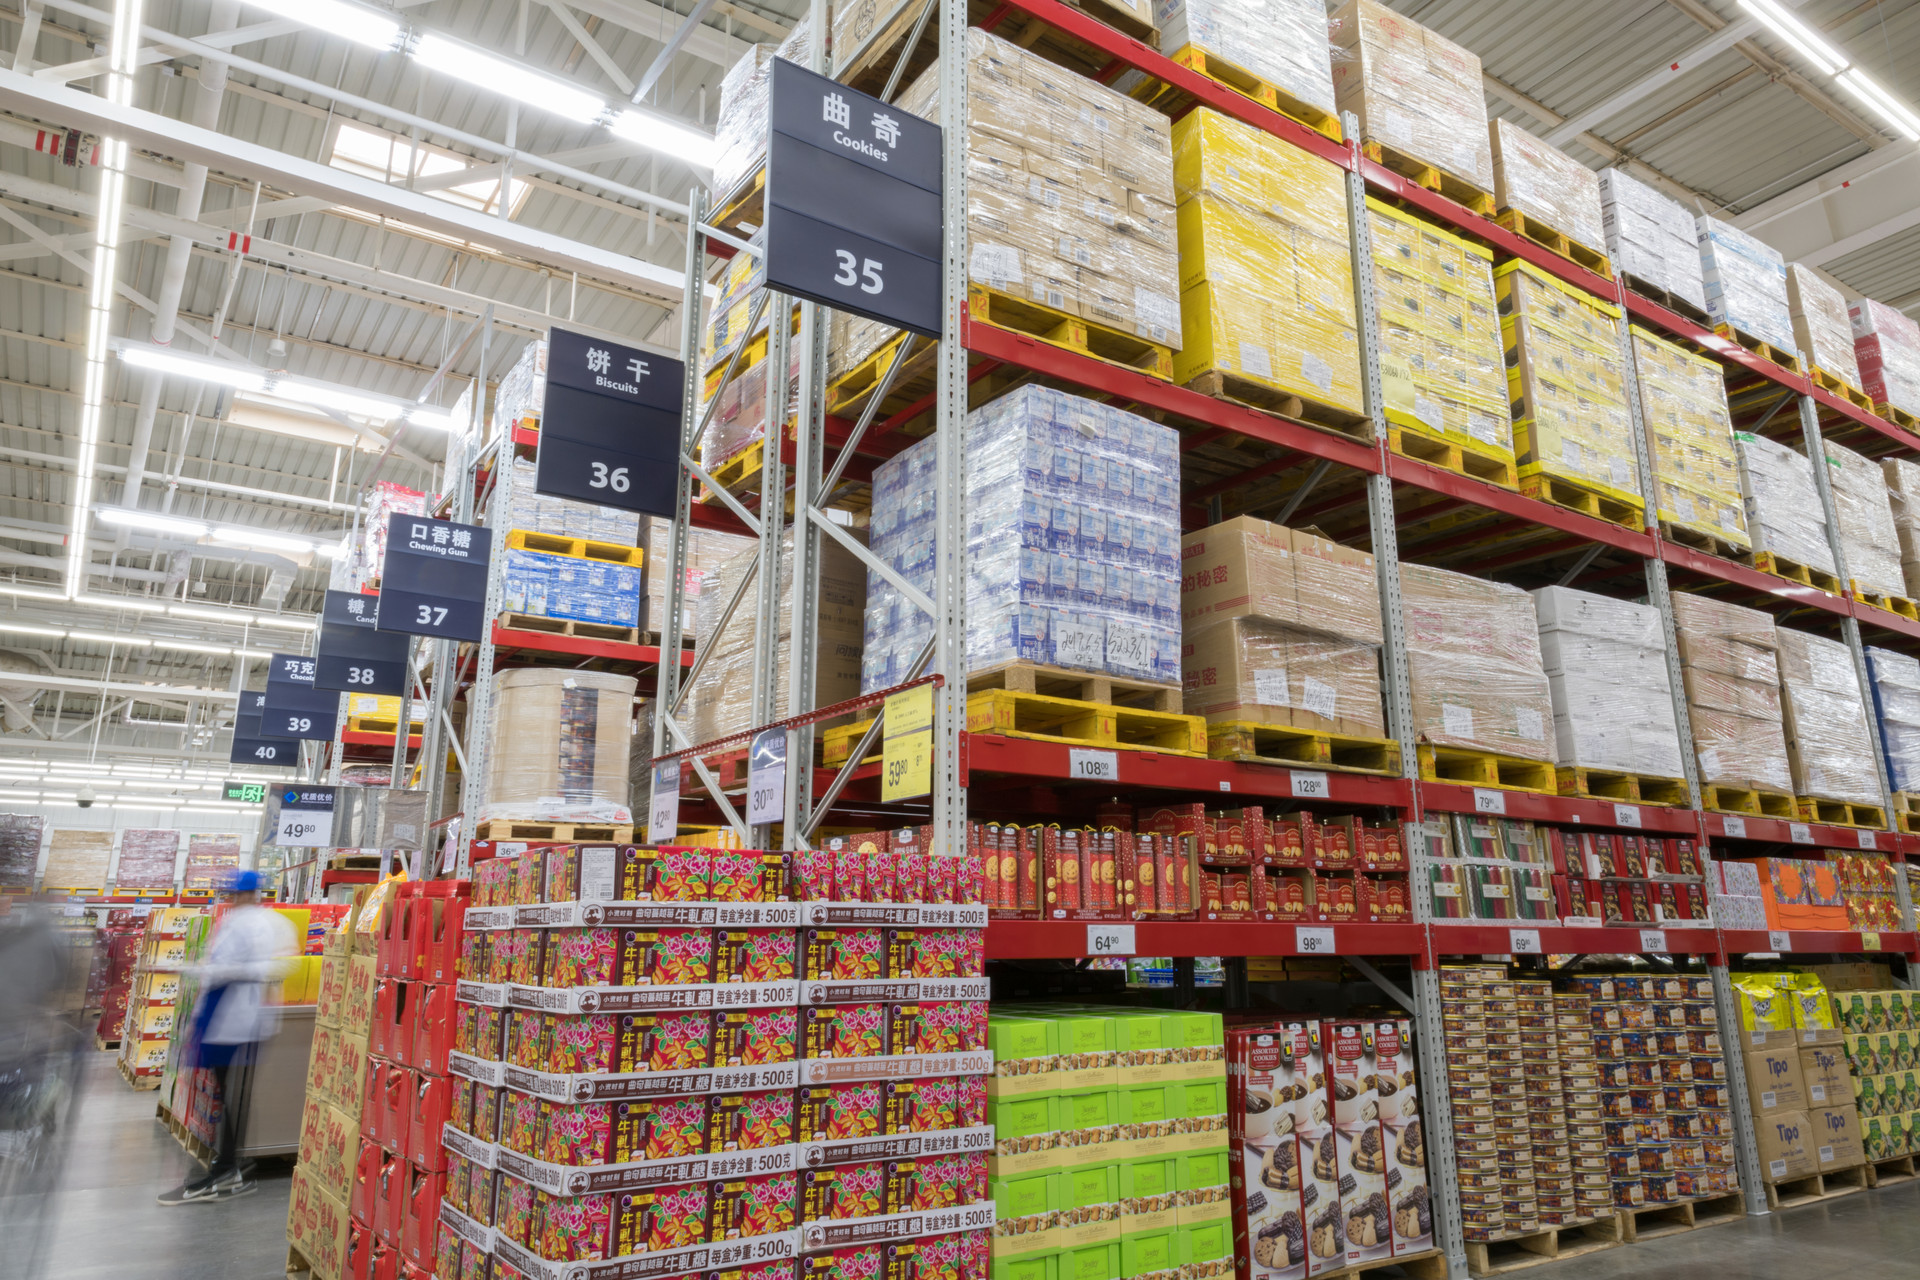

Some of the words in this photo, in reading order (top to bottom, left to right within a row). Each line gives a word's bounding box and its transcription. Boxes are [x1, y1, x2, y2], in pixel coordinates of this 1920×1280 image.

[823, 92, 901, 149] 曲奇
[833, 130, 888, 162] Cookies
[834, 249, 884, 295] 35
[974, 296, 987, 311] 12
[586, 347, 651, 383] 饼干
[595, 375, 639, 395] Biscuits
[589, 462, 631, 493] 36
[411, 523, 472, 549] 口香糖
[409, 541, 447, 555] Chewing
[448, 548, 468, 557] Gum
[347, 598, 379, 615] 糖
[416, 605, 449, 626] 37
[285, 660, 315, 675] 巧克
[347, 667, 375, 685] 38
[290, 674, 315, 682] Chocola
[1183, 667, 1217, 689] 秘密
[287, 717, 311, 732] 39
[255, 746, 276, 759] 40
[301, 792, 333, 802] 优质优价
[1766, 1057, 1788, 1078] Tipo
[1814, 1051, 1835, 1071] Tipo
[1825, 1112, 1845, 1132] Tipo
[1776, 1124, 1799, 1144] Tipo
